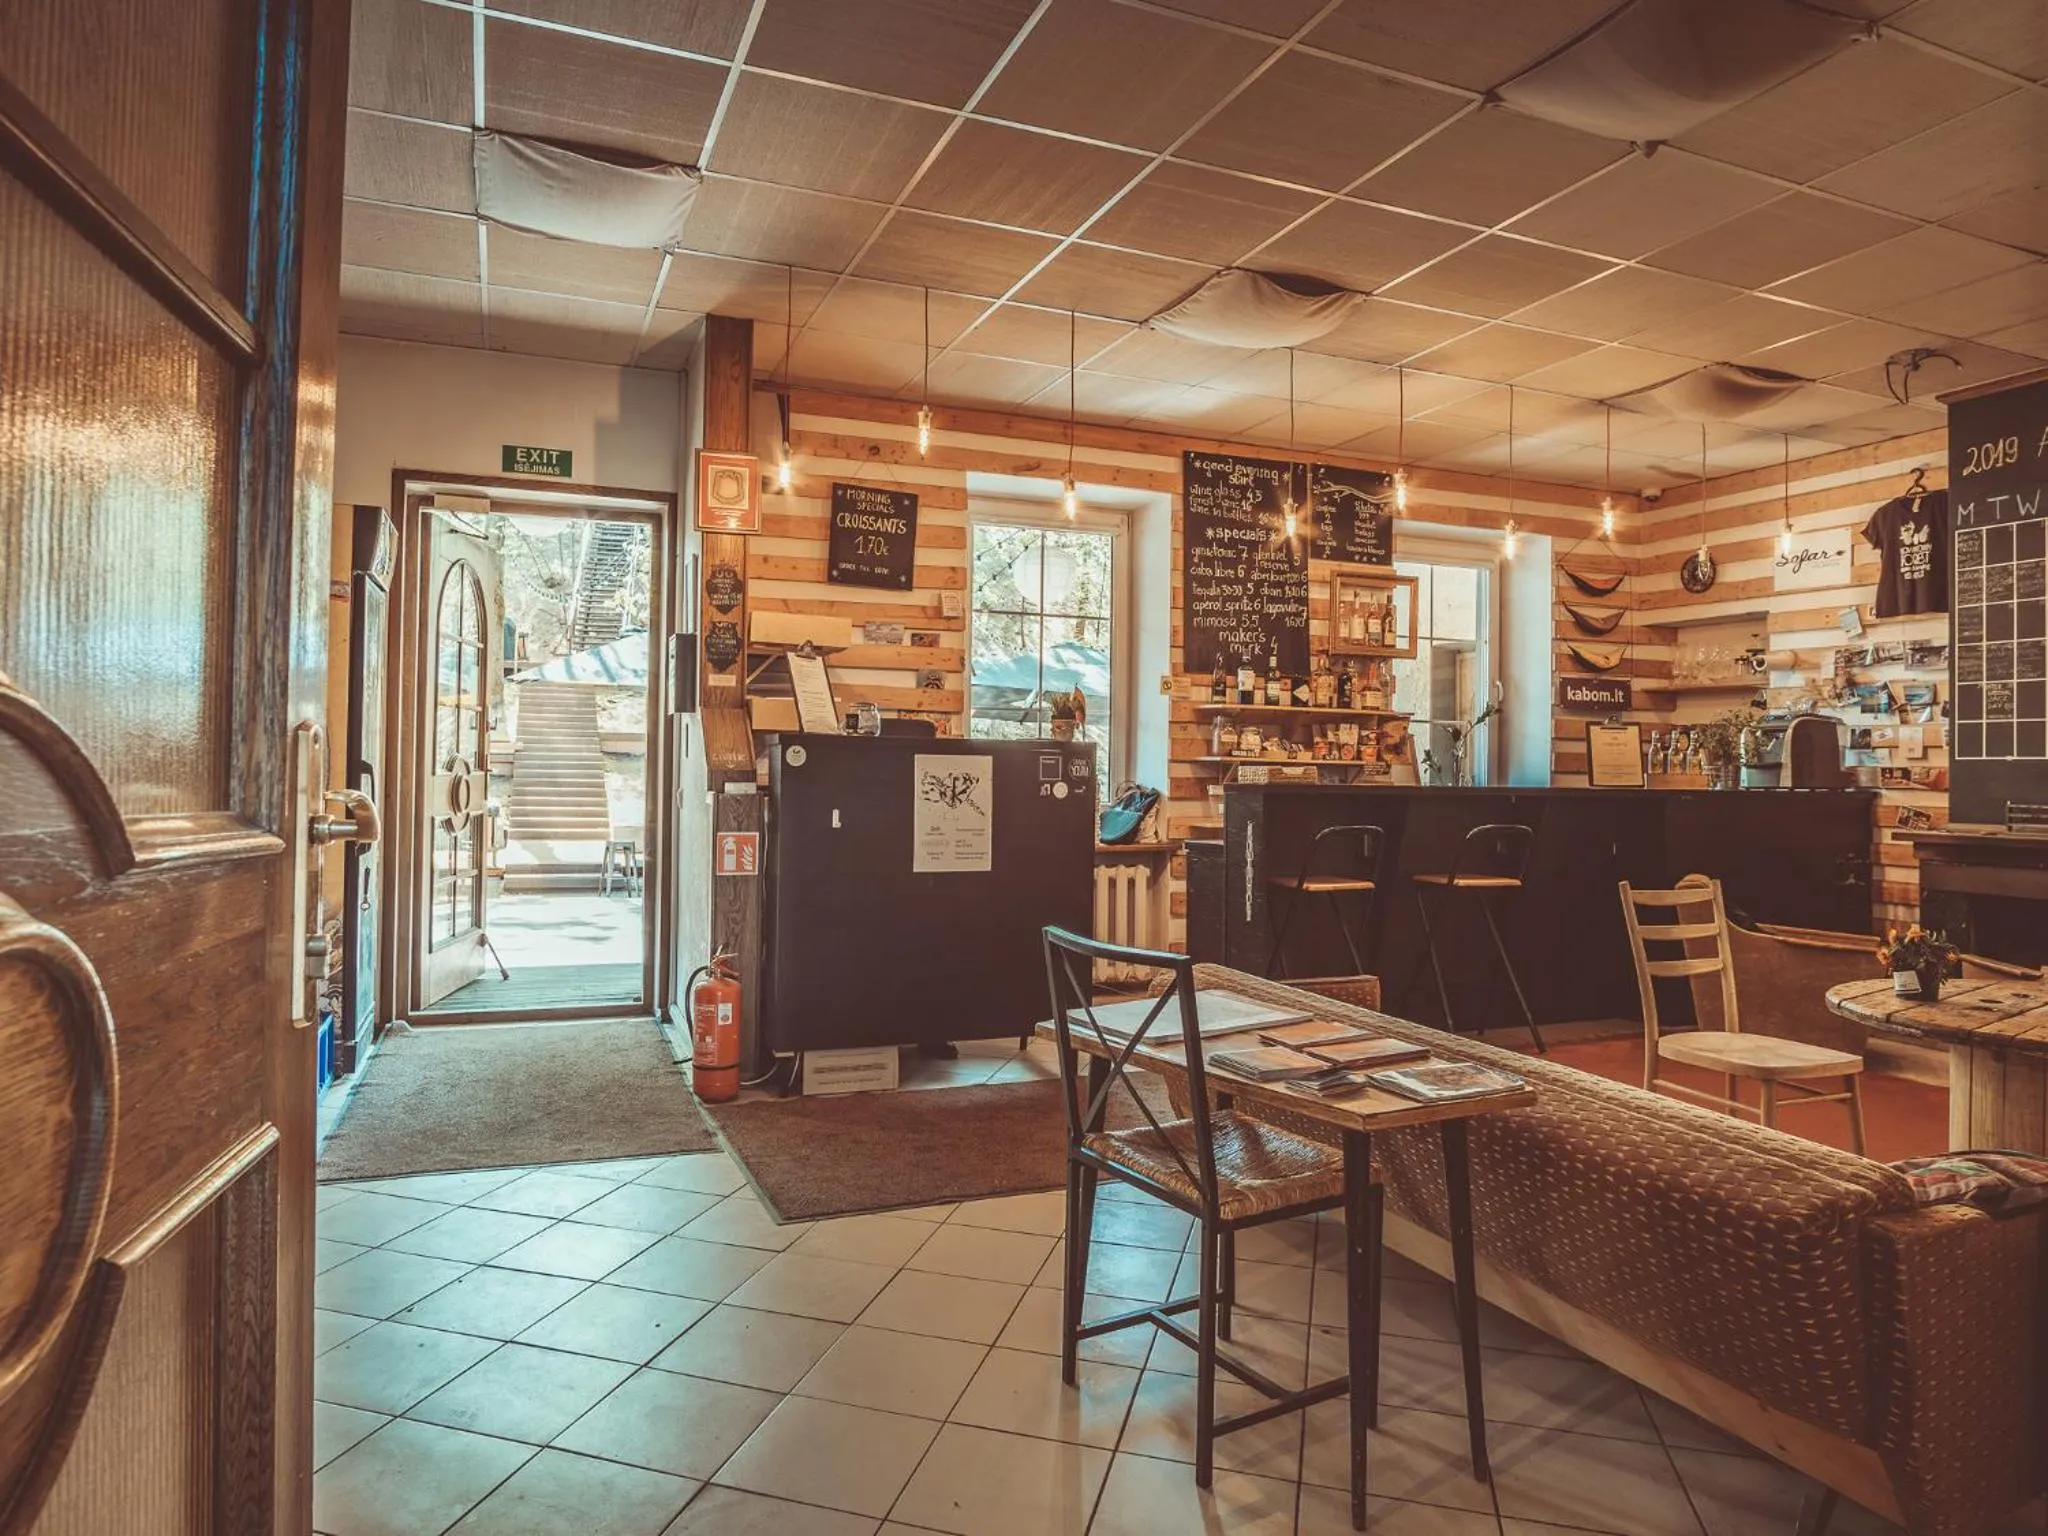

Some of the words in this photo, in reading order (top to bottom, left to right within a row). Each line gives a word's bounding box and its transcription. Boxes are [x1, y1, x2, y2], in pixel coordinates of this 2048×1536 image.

[516, 447, 560, 464] EXIT
[1962, 436, 2019, 476] 2019
[847, 489, 891, 505] MORNING
[856, 501, 896, 514] SPECIALS
[1957, 502, 1975, 525] M
[1987, 495, 2010, 520] T
[2016, 489, 2041, 516] W
[837, 512, 907, 535] CROISSANTS
[1237, 564, 1246, 578] 6
[1246, 582, 1255, 596] 5
[1192, 597, 1222, 615] aperol
[1254, 598, 1261, 611] 6
[1193, 616, 1237, 628] mimosa
[1220, 627, 1267, 643] maker's
[1567, 685, 1624, 703] kabom.lt
